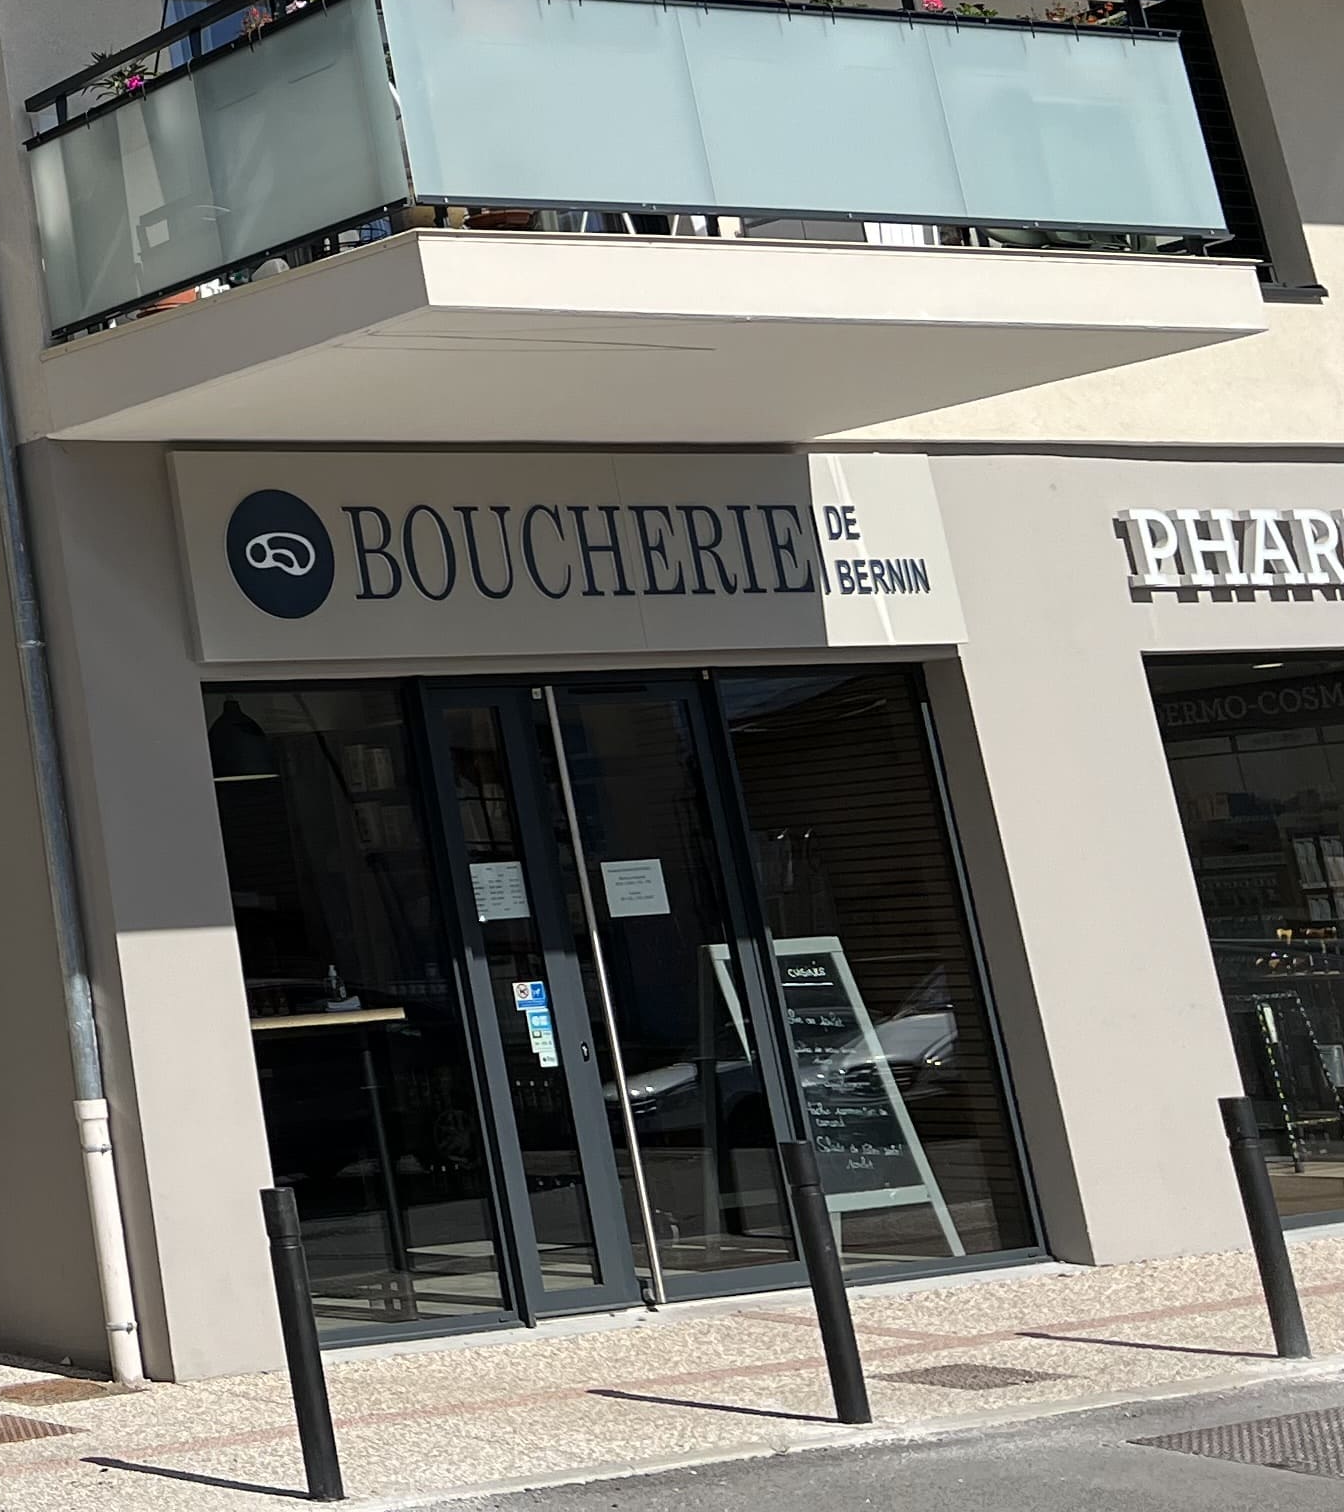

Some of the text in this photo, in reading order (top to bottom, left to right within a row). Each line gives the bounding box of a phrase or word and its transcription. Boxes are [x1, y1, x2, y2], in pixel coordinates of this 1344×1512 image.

[823, 505, 861, 541] DE
[1120, 508, 1344, 586] PHAR
[341, 504, 815, 601] BOUCHERIE
[834, 558, 931, 595] BERNIN
